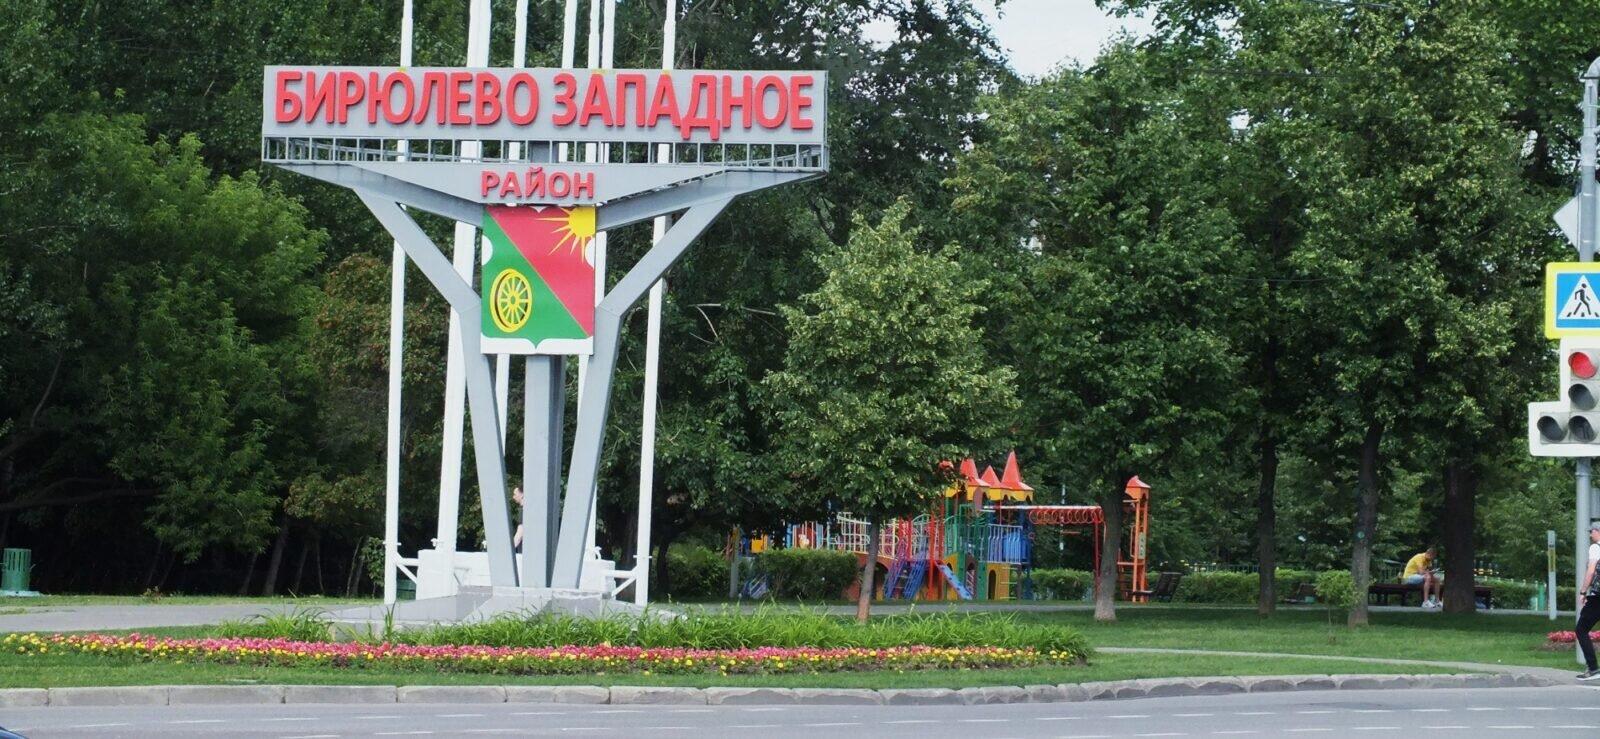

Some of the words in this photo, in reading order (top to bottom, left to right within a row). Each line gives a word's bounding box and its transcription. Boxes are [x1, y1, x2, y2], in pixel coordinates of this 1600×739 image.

[275, 70, 539, 126] БИРЮЛЕВО
[552, 73, 814, 140] ЗАПАДНОЕ
[480, 166, 595, 199] РАЙОН
